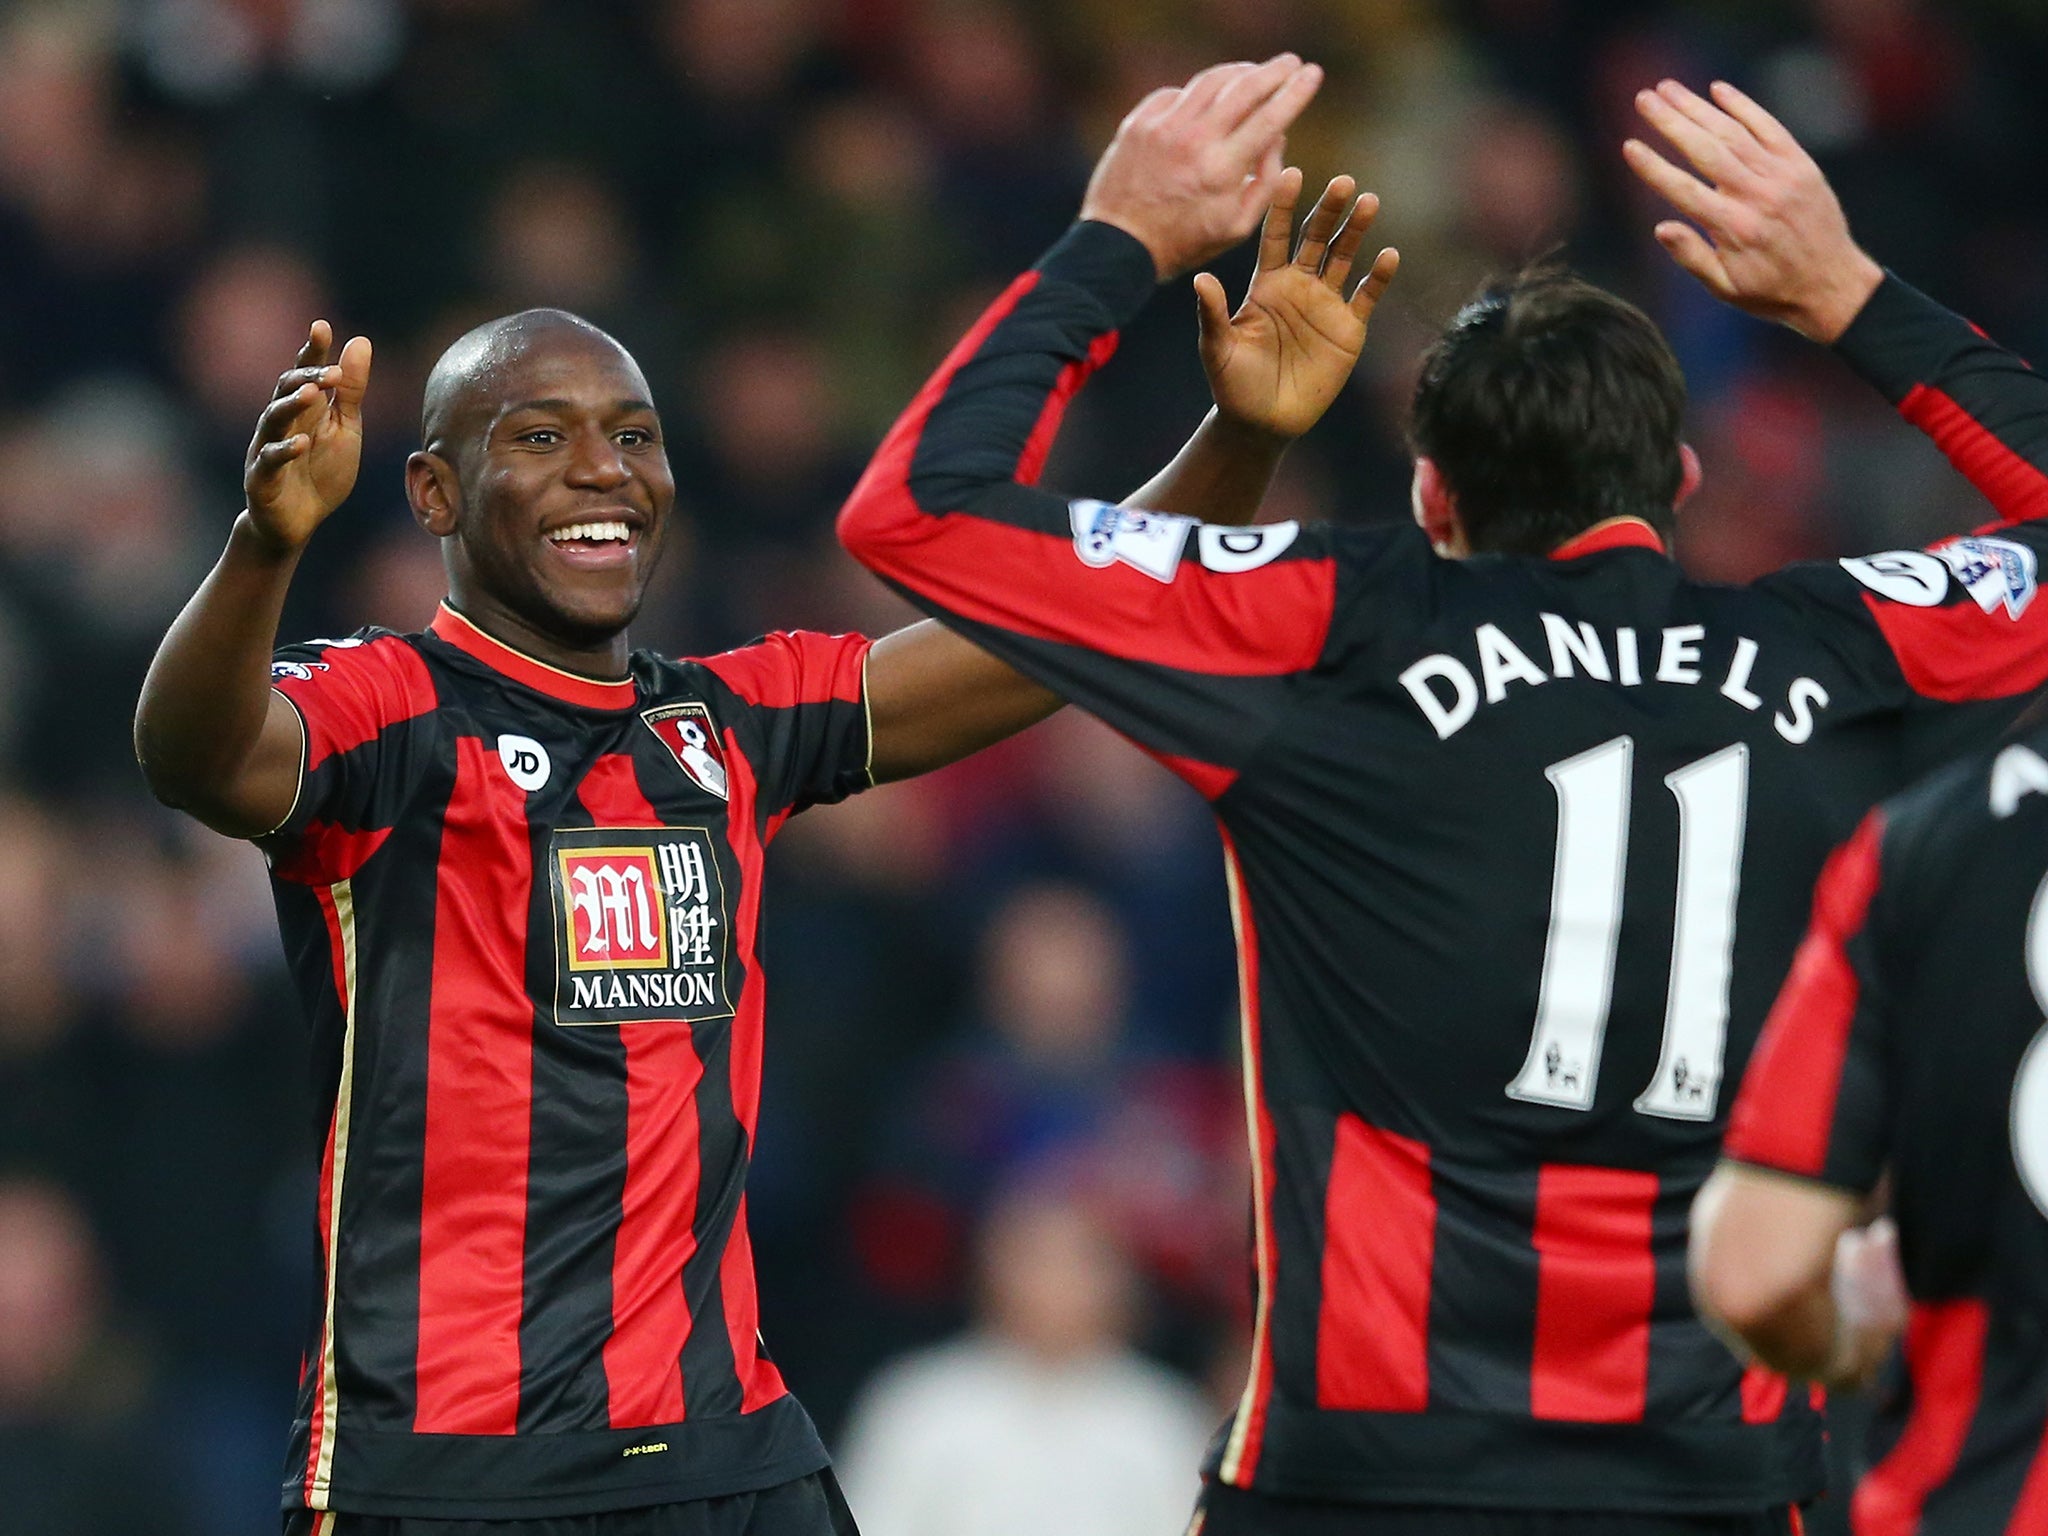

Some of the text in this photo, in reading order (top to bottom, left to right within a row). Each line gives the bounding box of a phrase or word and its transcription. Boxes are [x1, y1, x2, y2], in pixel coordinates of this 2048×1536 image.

[1398, 611, 1830, 745] DANIELS
[509, 750, 540, 775] JD
[1505, 733, 1750, 1122] 11
[569, 972, 715, 1009] MANSION
